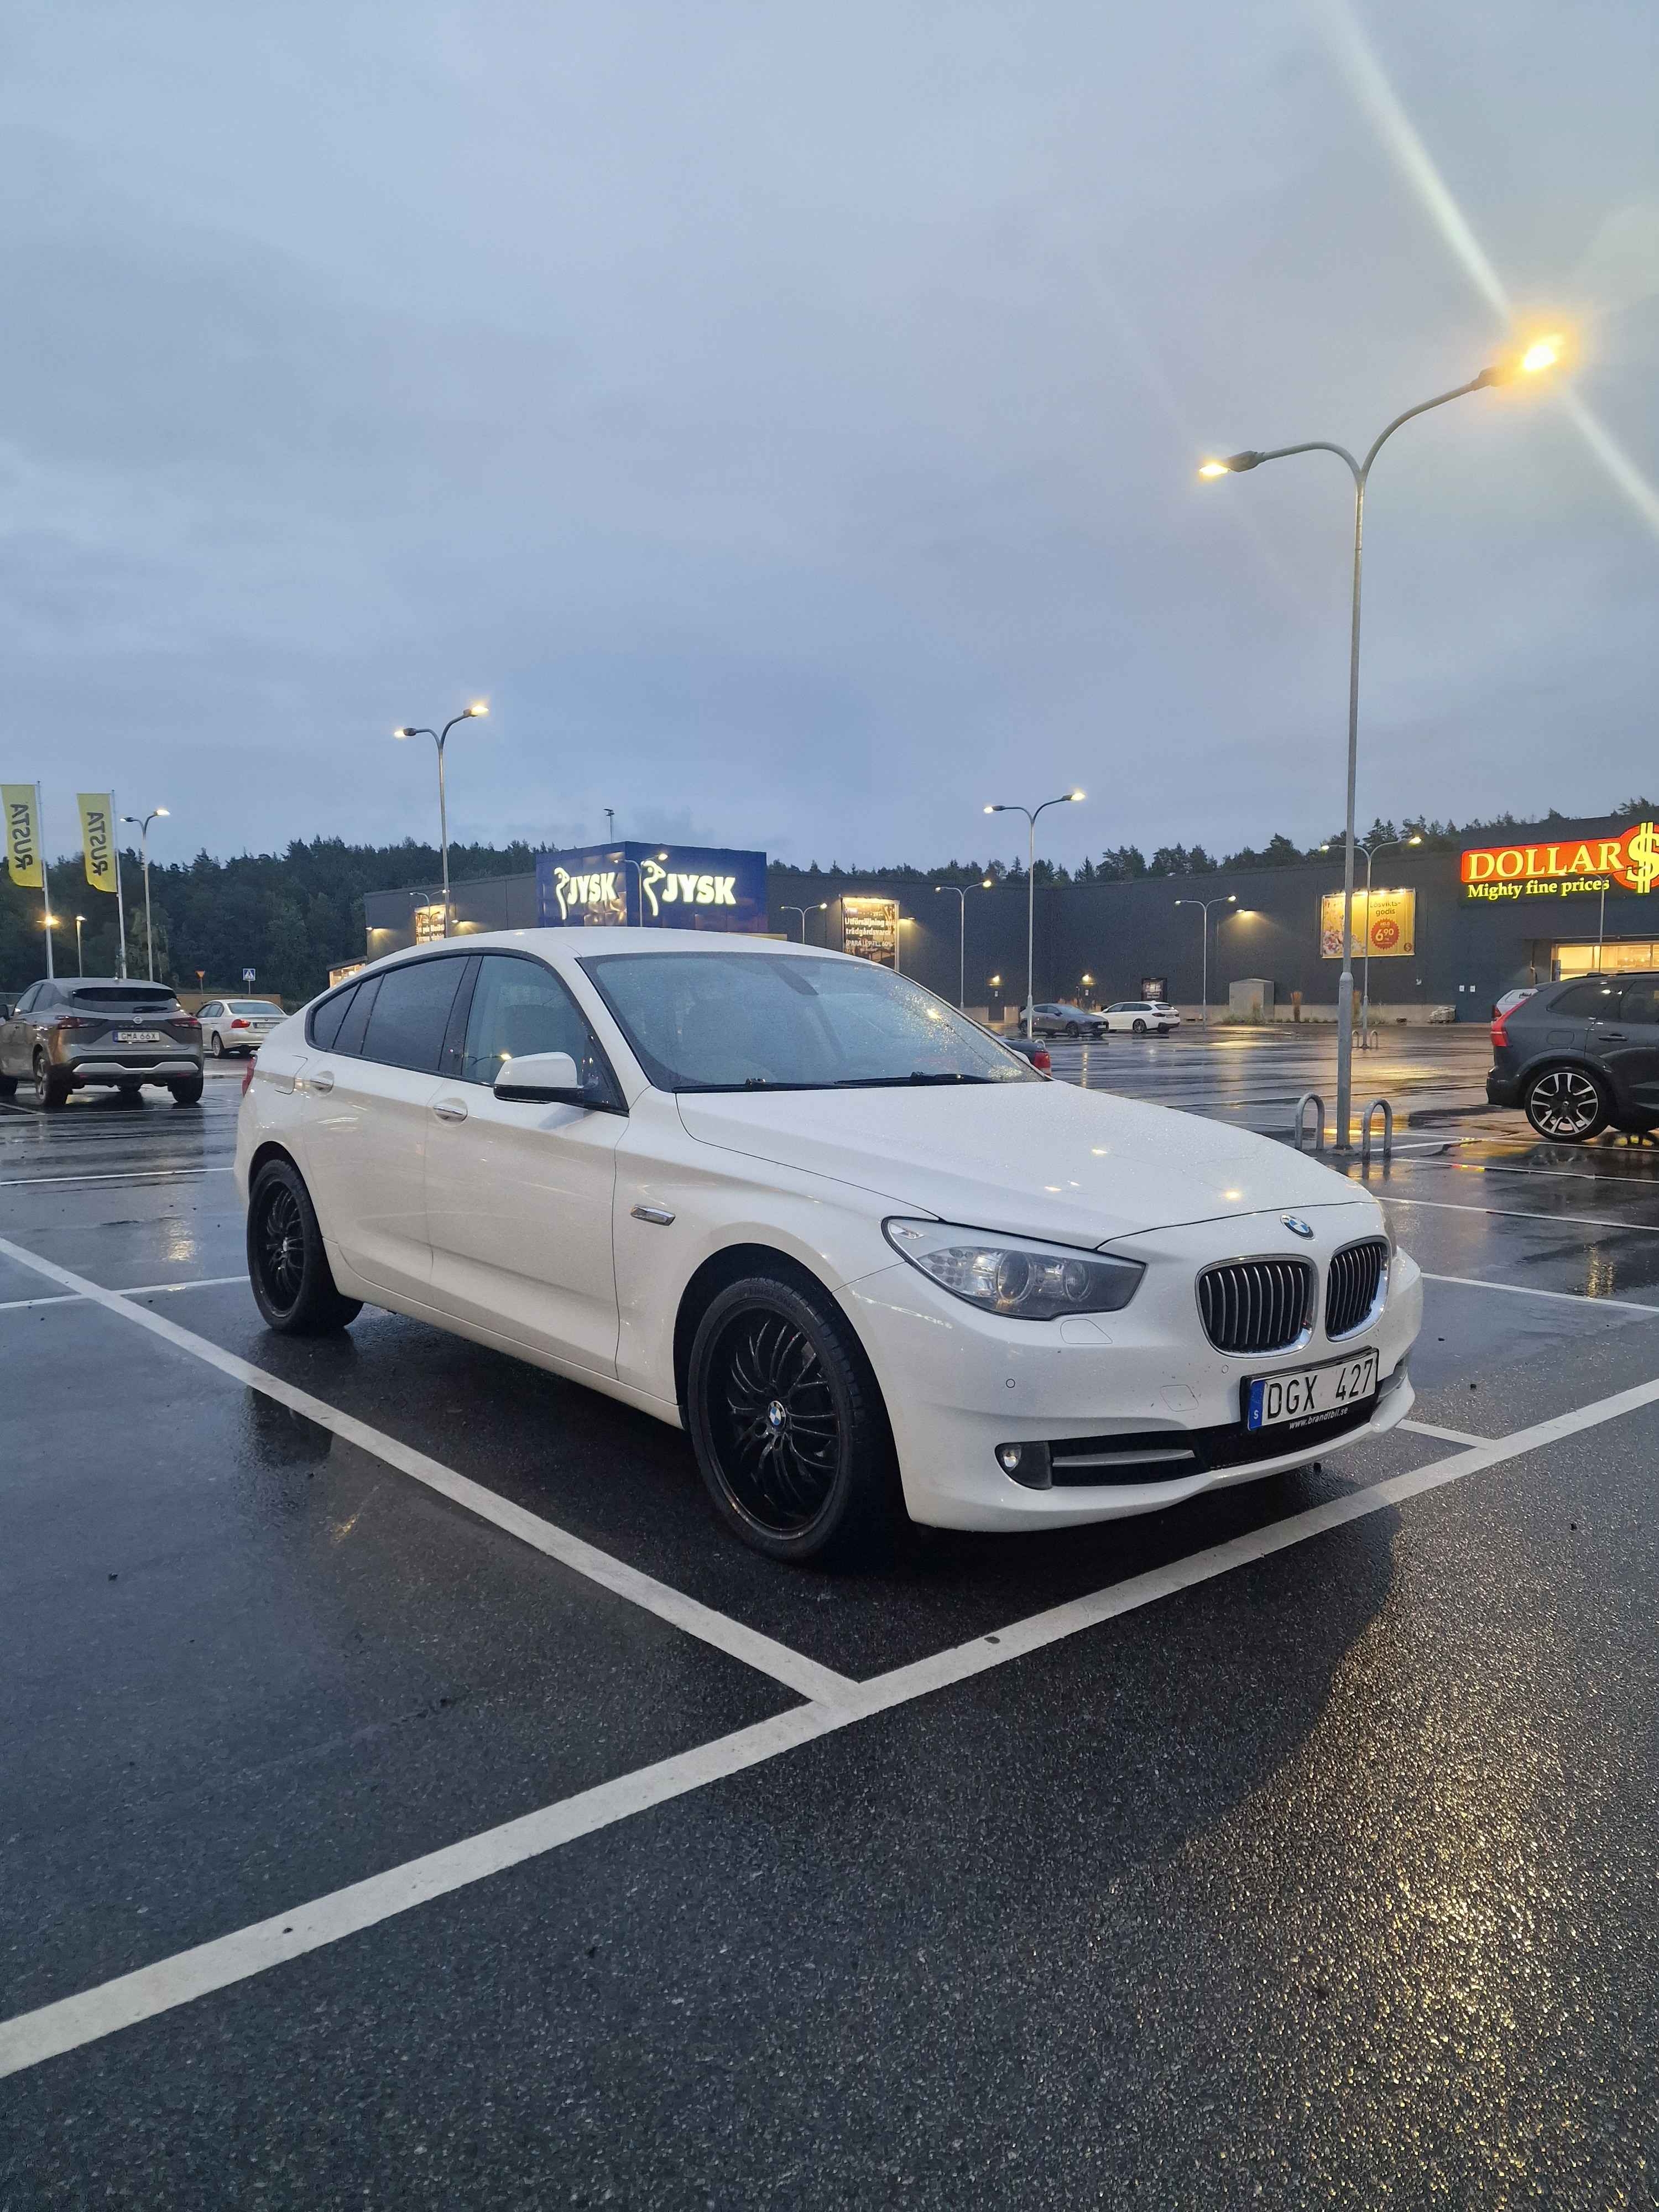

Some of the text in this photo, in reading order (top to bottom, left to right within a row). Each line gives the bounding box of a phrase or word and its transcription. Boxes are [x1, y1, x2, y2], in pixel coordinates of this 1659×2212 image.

[1468, 842, 1624, 879] DOLLAR
[567, 872, 617, 905] JYSK
[662, 873, 736, 905] JYSK
[1467, 877, 1610, 900] Mighty fine prices
[1375, 908, 1396, 916] godis
[1267, 1358, 1374, 1420] DGX 427
[1253, 1410, 1259, 1420] S
